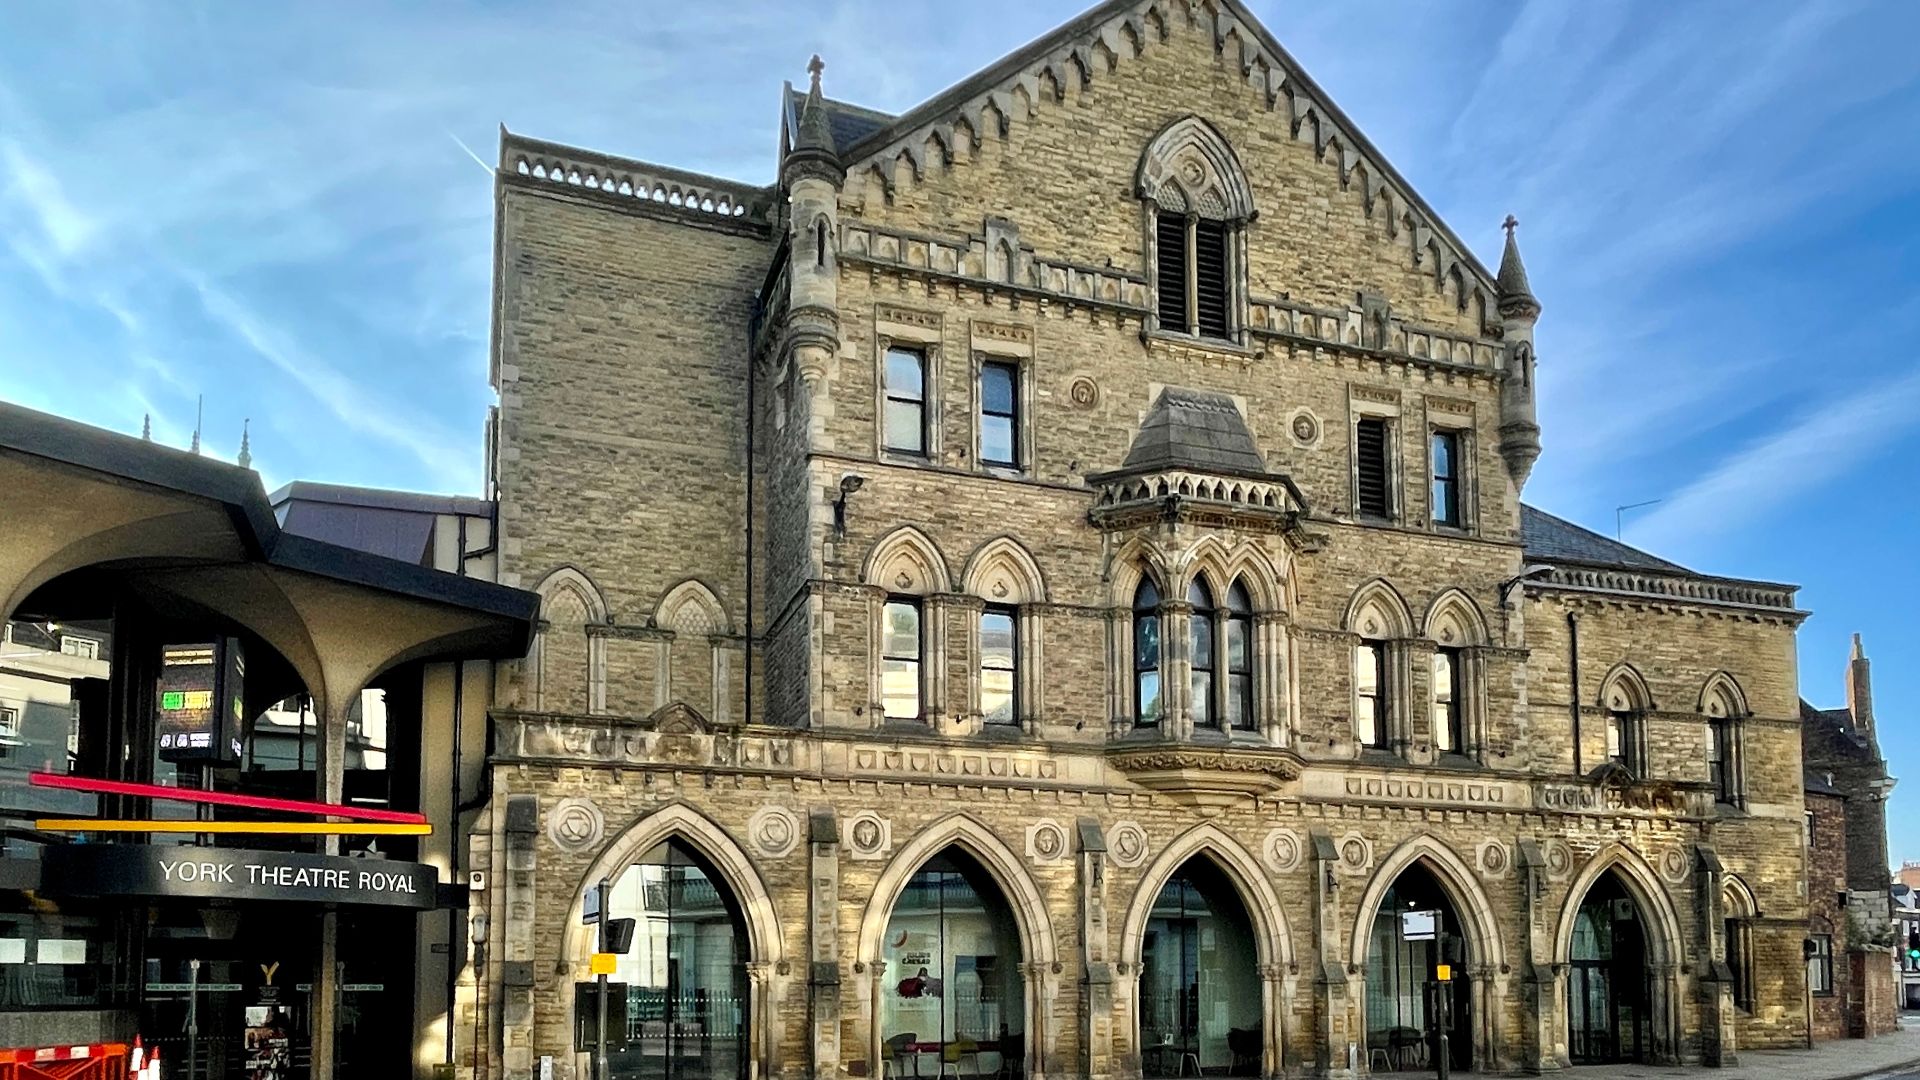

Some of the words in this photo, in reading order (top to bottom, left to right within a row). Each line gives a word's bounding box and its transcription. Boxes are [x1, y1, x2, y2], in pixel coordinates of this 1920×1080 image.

[158, 860, 234, 883] YORK
[244, 864, 350, 889] THEATRE
[358, 871, 417, 893] ROYAL
